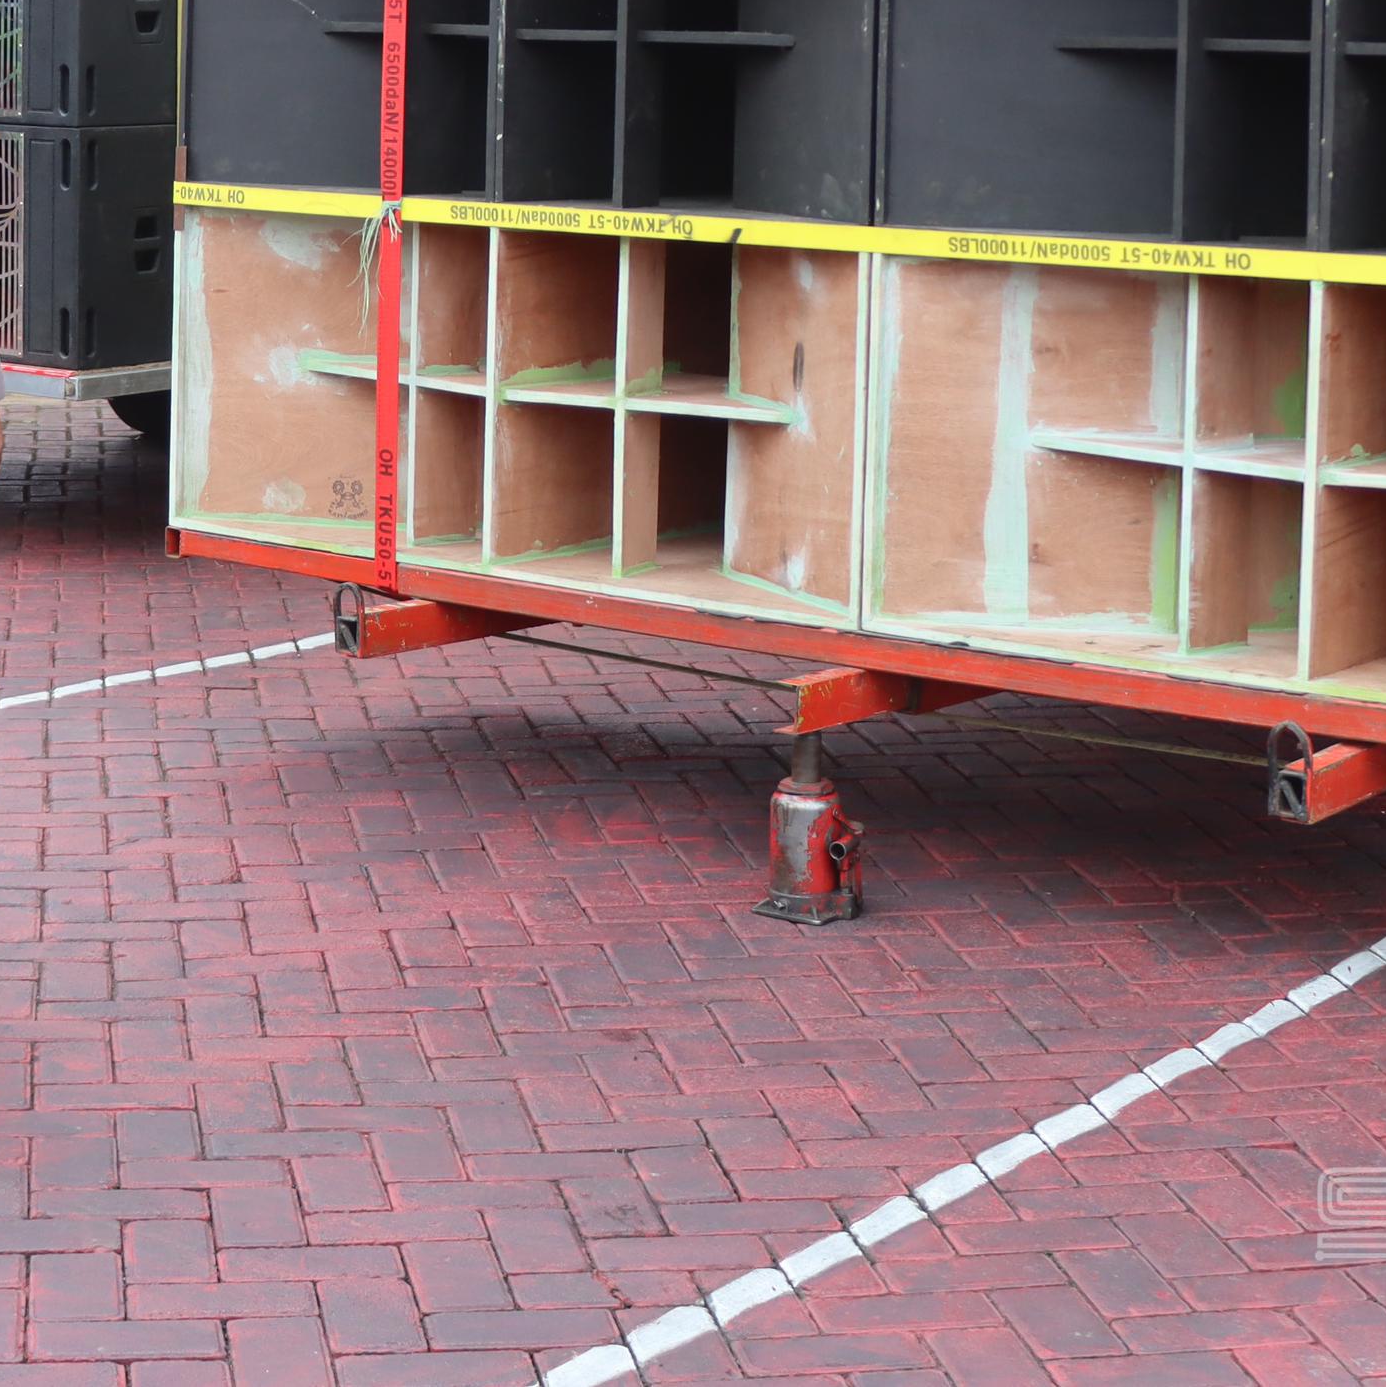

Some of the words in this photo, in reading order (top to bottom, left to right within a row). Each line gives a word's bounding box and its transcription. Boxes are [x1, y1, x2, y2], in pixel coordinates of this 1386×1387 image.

[227, 189, 245, 204] OH
[449, 204, 581, 228] 5000daN/11000LBS
[587, 214, 666, 233] TKW40-5T
[672, 219, 694, 236] OH
[948, 236, 1111, 262] 5000daN/11000LBS
[1120, 247, 1214, 268] TKW40-5T
[1225, 252, 1252, 270] OH
[378, 449, 394, 477] OH
